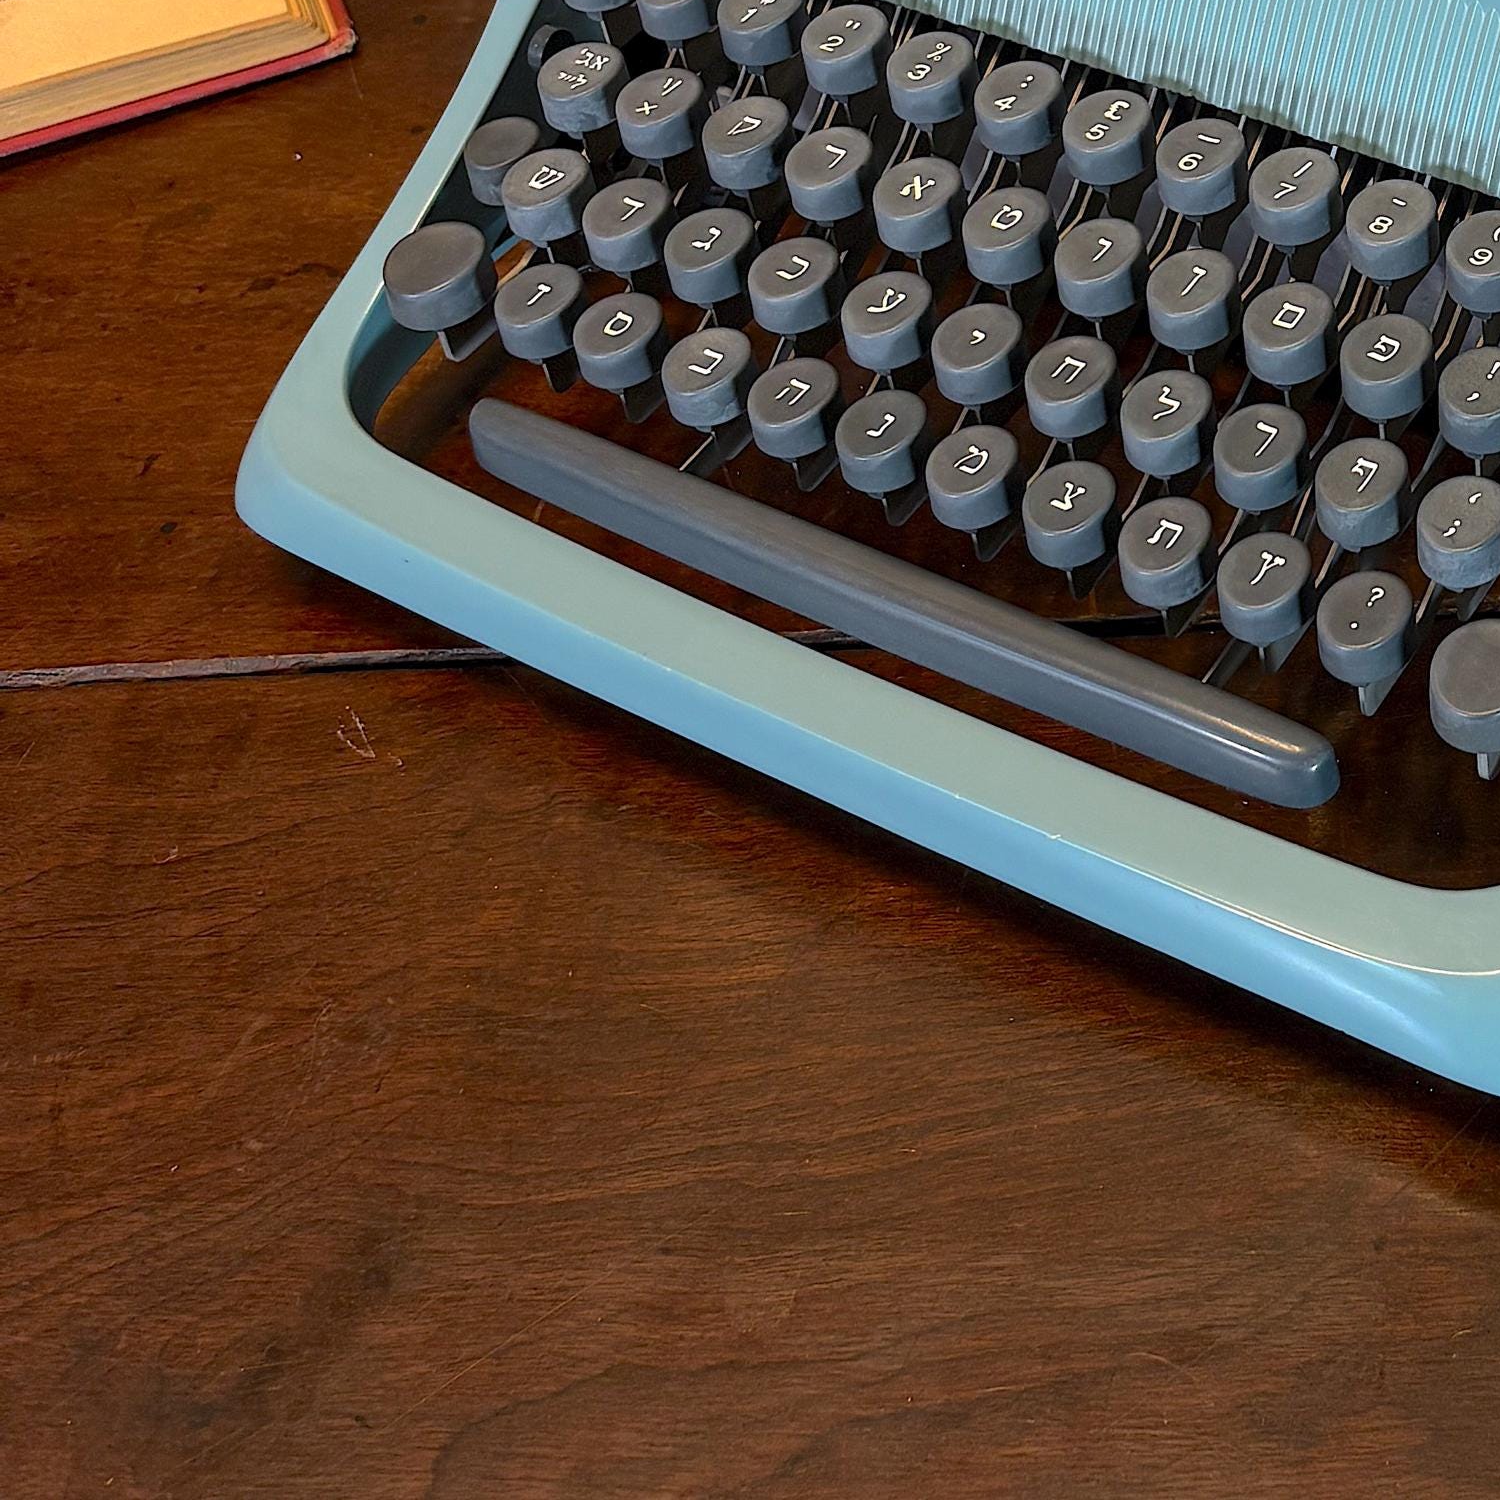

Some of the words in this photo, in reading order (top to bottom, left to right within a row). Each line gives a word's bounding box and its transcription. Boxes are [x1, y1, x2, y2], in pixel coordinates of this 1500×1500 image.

[740, 8, 758, 23] 1
[819, 35, 844, 52] 2
[926, 42, 952, 61] %
[907, 64, 931, 80] 3
[994, 96, 1017, 111] 4
[727, 115, 762, 135] ק
[1085, 123, 1109, 140] 5
[1178, 153, 1203, 171] 6
[528, 165, 565, 190] ש
[899, 175, 936, 200] א
[1273, 182, 1297, 199] 7
[990, 205, 1023, 230] ט
[1368, 216, 1393, 234] 8
[691, 227, 721, 251] ג
[1468, 248, 1493, 266] 9
[866, 288, 906, 313] ע
[603, 311, 633, 336] ס
[1366, 335, 1400, 362] פ
[688, 348, 724, 375] ב
[1051, 356, 1086, 383] ח
[775, 378, 811, 405] ה
[1153, 386, 1181, 420] ל
[866, 413, 895, 437] נ
[953, 445, 989, 474] מ
[1351, 457, 1378, 493] ף
[1050, 482, 1086, 511] צ
[1146, 519, 1183, 549] ת
[1250, 551, 1286, 585] ץ
